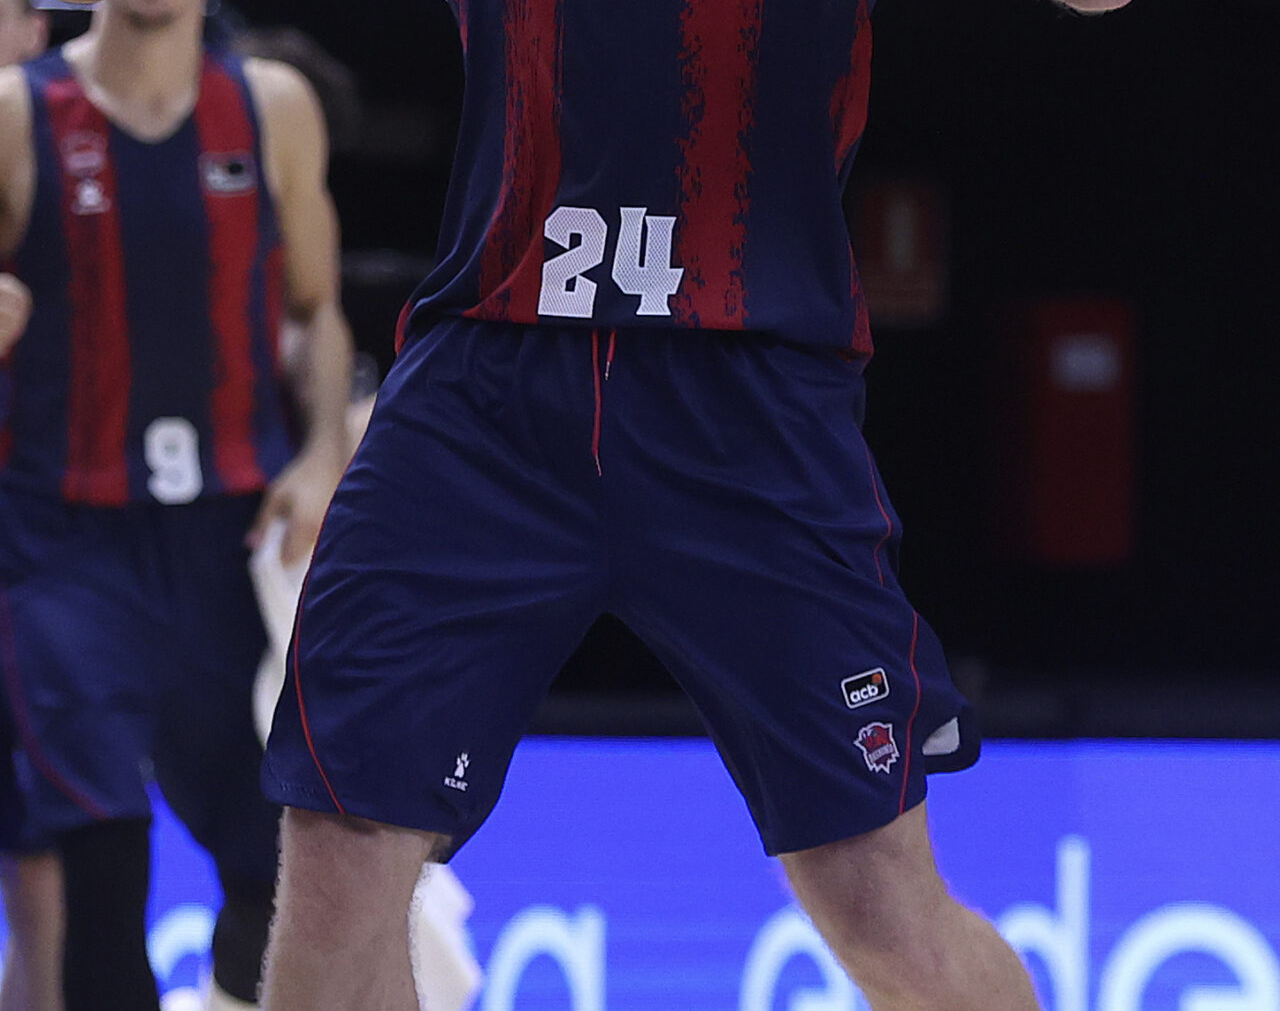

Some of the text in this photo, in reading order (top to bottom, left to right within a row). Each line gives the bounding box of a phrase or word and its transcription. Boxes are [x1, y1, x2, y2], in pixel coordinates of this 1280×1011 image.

[537, 206, 685, 319] 24
[144, 416, 204, 505] 9
[849, 684, 879, 703] acb
